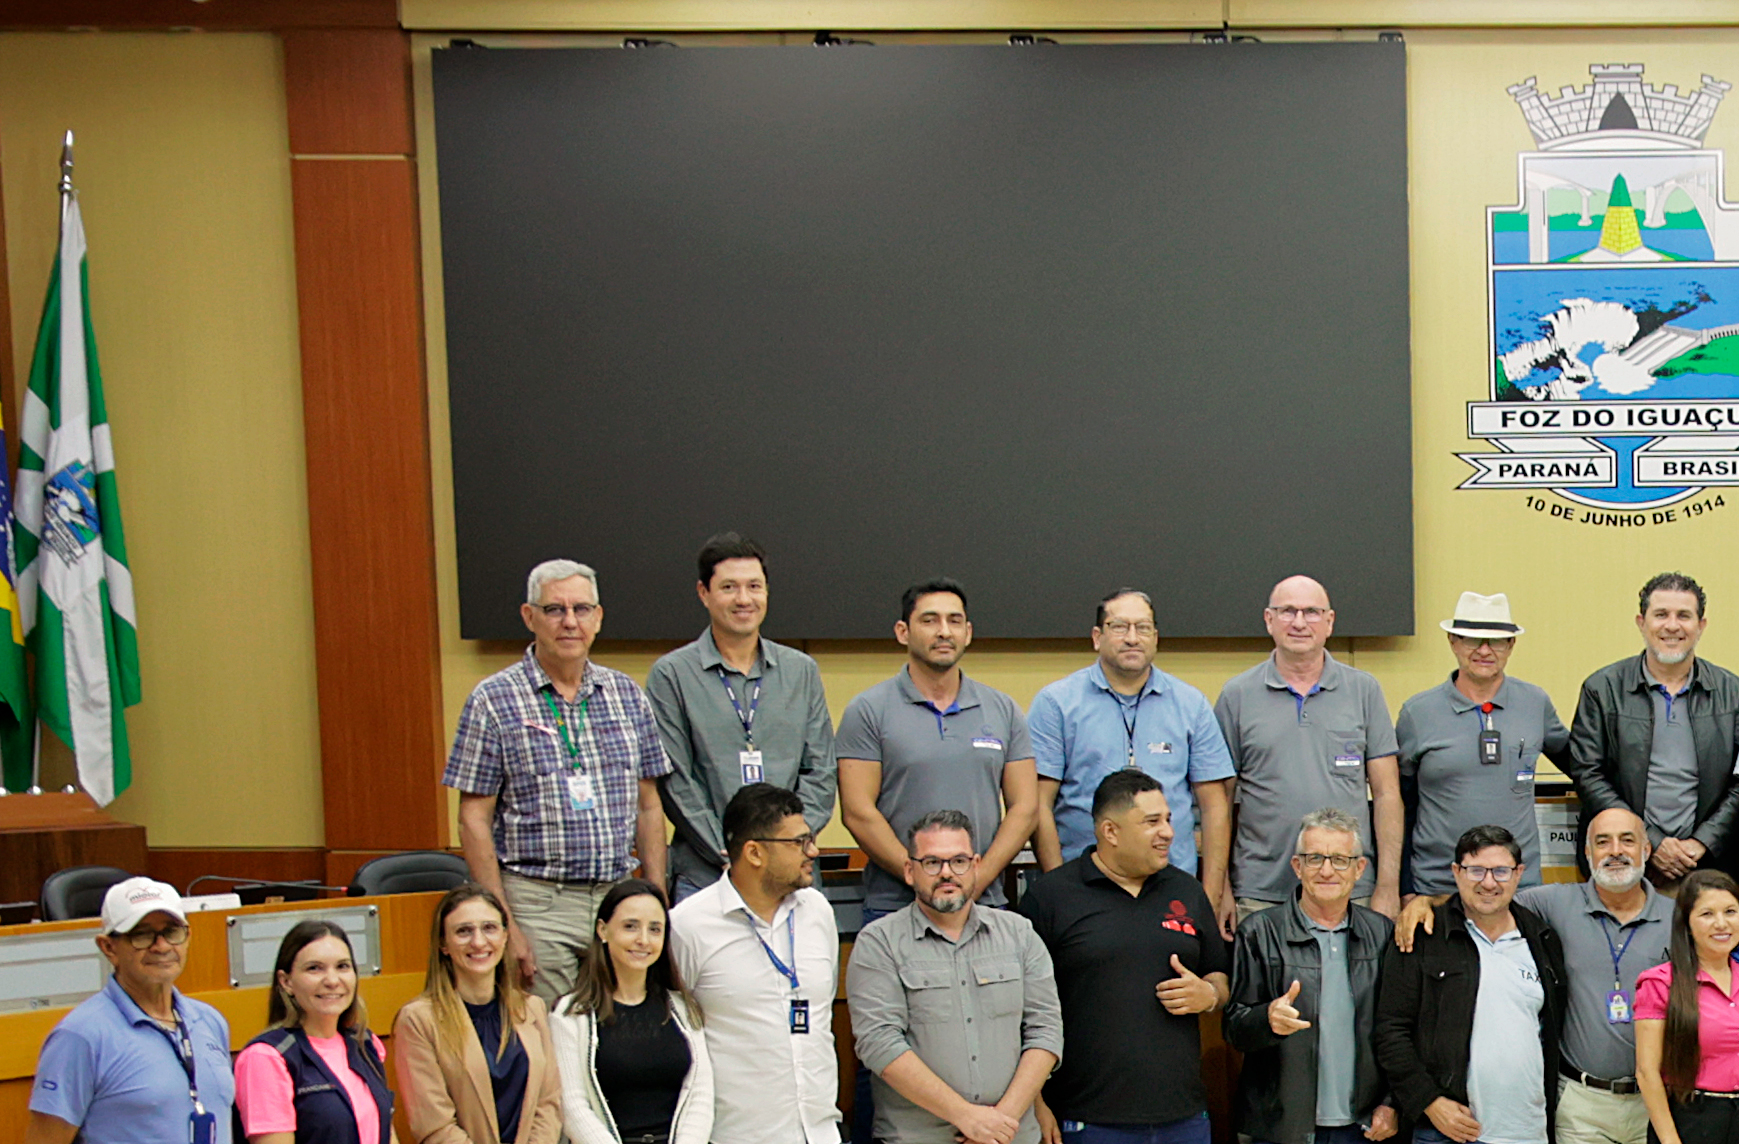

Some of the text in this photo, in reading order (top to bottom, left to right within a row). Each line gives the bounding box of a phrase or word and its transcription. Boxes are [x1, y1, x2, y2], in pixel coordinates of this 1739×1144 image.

[1501, 410, 1561, 428] FOZ
[1573, 410, 1615, 427] DO
[1498, 458, 1600, 478] PARANÁ
[1525, 494, 1726, 528] 10 DE JUNHO DE 1914
